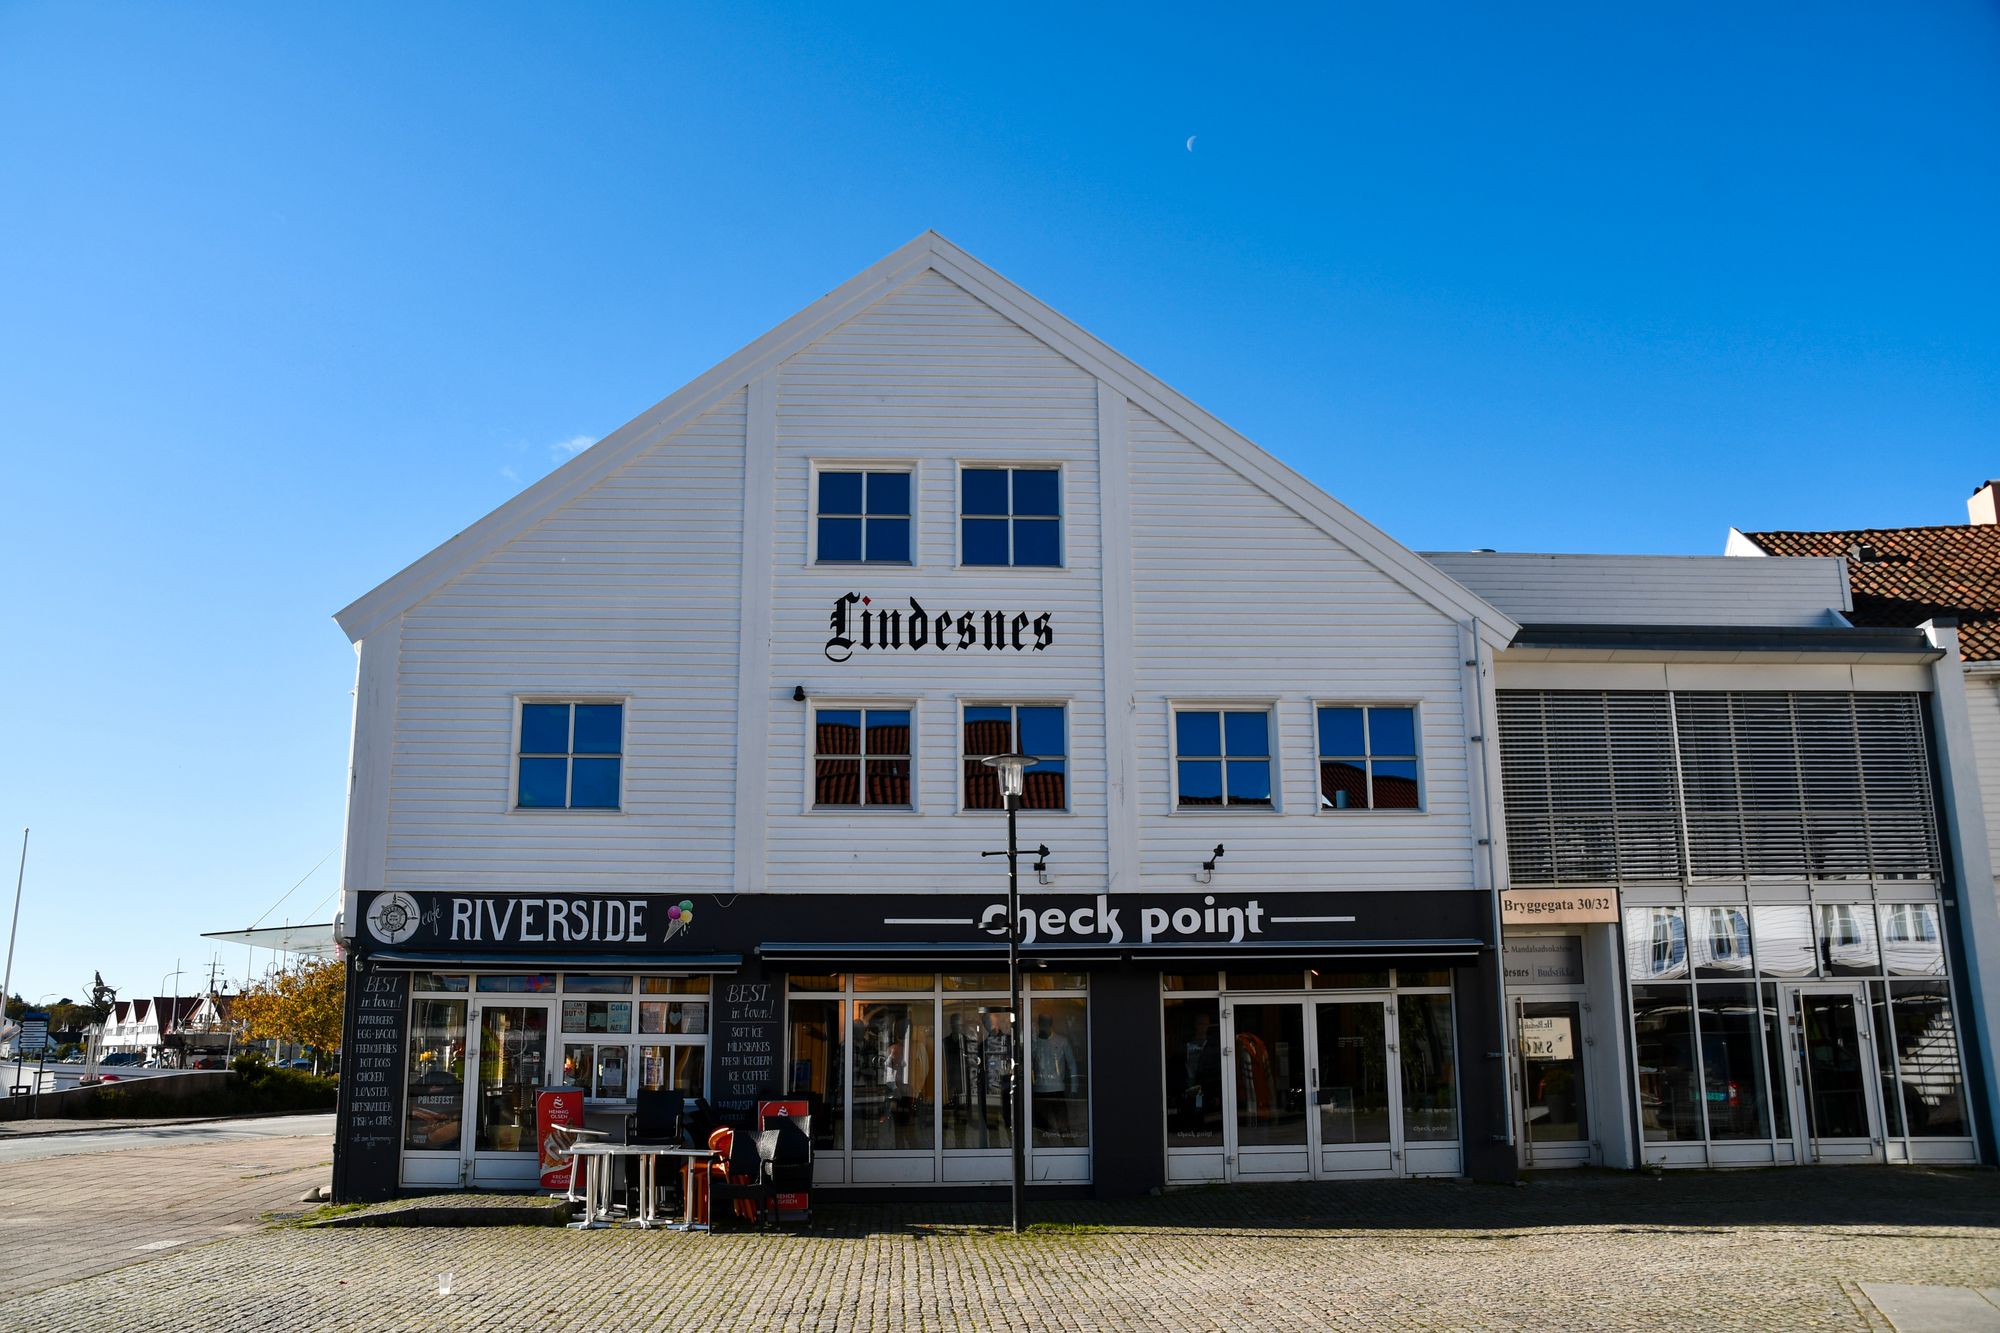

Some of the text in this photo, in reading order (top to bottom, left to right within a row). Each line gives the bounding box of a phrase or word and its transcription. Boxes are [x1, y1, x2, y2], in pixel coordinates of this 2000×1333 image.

[825, 591, 1053, 663] Lindesnes
[1503, 898, 1610, 914] Bryggegata 30/32
[421, 897, 648, 942] café RIVERSIDE
[981, 894, 1264, 944] check point
[363, 976, 402, 993] BEST
[725, 984, 771, 1003] BEST
[732, 1000, 775, 1019] in town!
[731, 1026, 763, 1038] SOFT ICE
[356, 1072, 385, 1082] CHICKEN
[417, 1096, 455, 1104] PØLSEFEST
